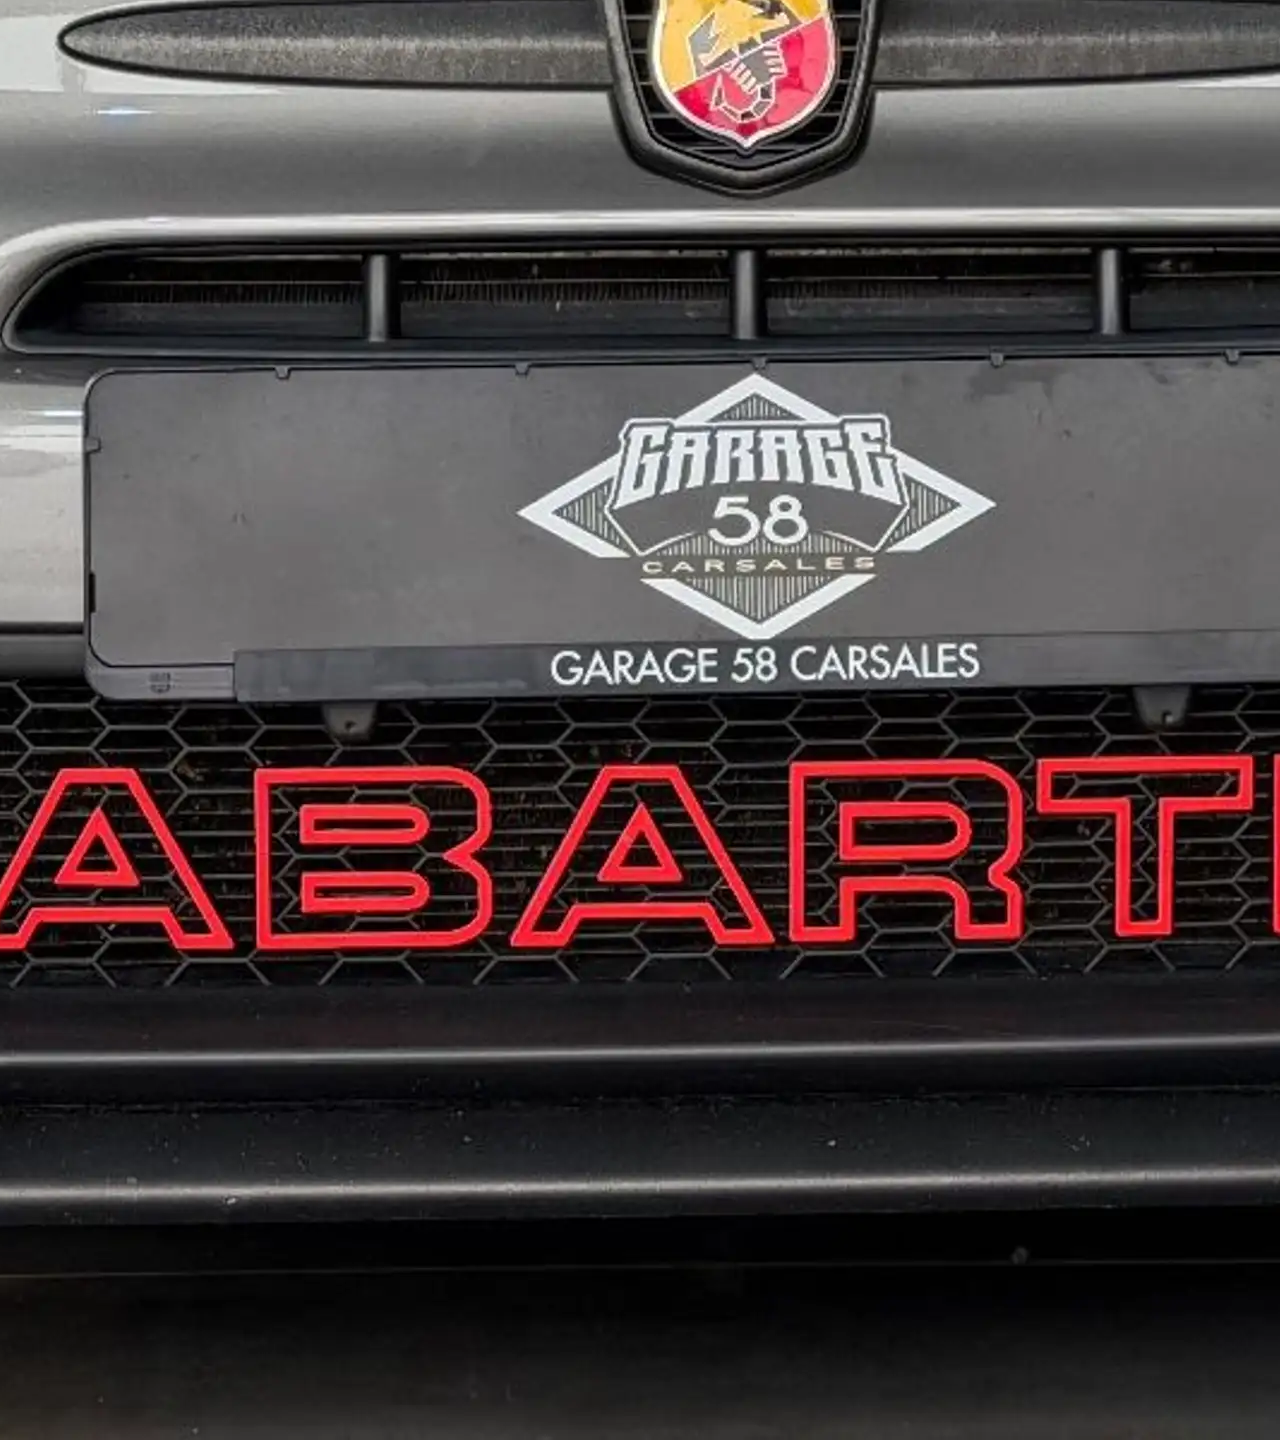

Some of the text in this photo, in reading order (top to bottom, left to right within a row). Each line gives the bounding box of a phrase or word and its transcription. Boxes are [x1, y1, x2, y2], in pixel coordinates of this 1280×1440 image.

[610, 422, 903, 510] GARAGE
[707, 494, 809, 546] 58
[641, 556, 875, 575] CARSALES
[550, 642, 981, 686] GARAGE 58 CARSALES
